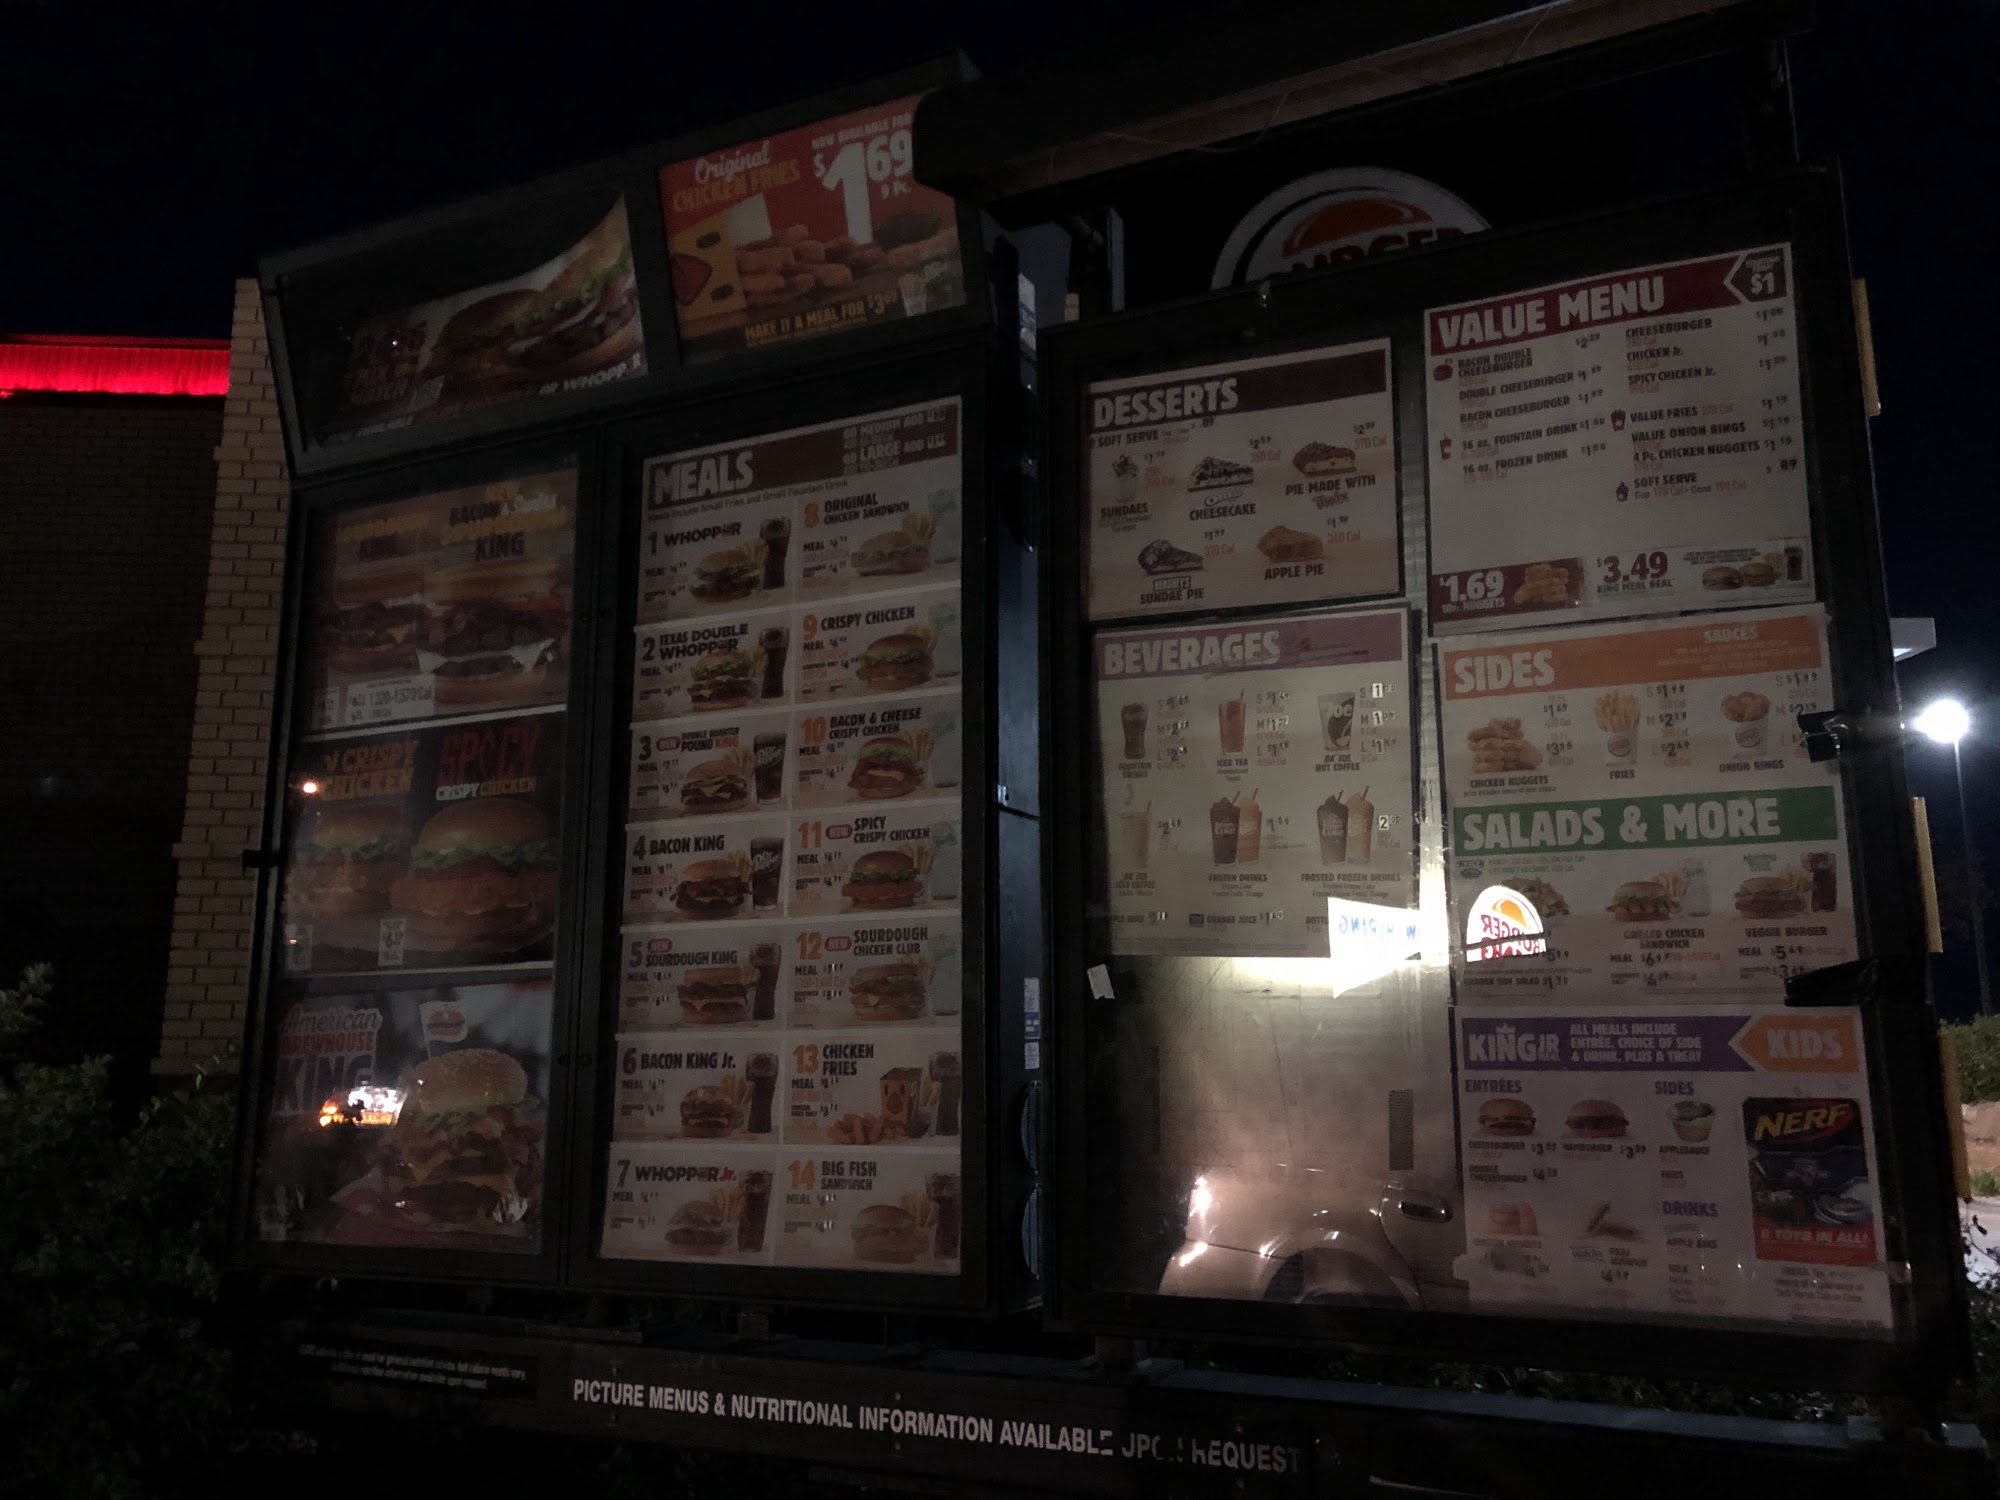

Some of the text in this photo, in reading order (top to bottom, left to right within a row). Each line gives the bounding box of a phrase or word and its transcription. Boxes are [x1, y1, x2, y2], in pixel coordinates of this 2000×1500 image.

[694, 139, 772, 184] Original
[672, 158, 800, 212] CHICKEN FRIES
[1751, 271, 1776, 295] $1
[745, 320, 776, 342] MAKE
[806, 307, 839, 328] MEAL
[842, 300, 865, 321] FOR
[1438, 275, 1666, 349] VALUE MENU
[1625, 317, 1713, 338] CHEESEBURGER
[1459, 348, 1533, 368] BACON DOUBLE
[1626, 347, 1670, 362] CHICKEN
[562, 352, 642, 391] WHOPPR
[1459, 358, 1533, 377] CHEESEBURGER
[1628, 366, 1702, 385] SPICY CHICKEN
[1459, 371, 1574, 399] DOUBLE CHEESEBURGER
[1094, 378, 1239, 428] DESSERTS
[1460, 395, 1571, 423] BACON CHEESEBURGER
[860, 414, 901, 436] MEDIUM
[1630, 406, 1699, 423] VALUE FRIES
[1098, 434, 1123, 447] SOFT
[1126, 429, 1159, 444] SERVE
[1462, 423, 1577, 451] 16 FOUNTAIN DRINK
[1631, 422, 1746, 442] VALUE ONION RINGS
[860, 439, 901, 460] LARGE
[1495, 449, 1568, 470] FROZEN DRINK
[1659, 440, 1760, 460] CHICKEN NUGGETS
[653, 450, 754, 504] MEALS
[826, 478, 849, 492] Drink
[1285, 474, 1376, 496] PIE MADE WITH
[1634, 473, 1697, 488] SOFT SERVE
[804, 492, 879, 528] 8 ORIGINAL
[823, 500, 910, 525] CHICKEN SANDWICH
[1101, 502, 1149, 519] SUNDAES
[1189, 503, 1256, 521] CHEESECAKE
[475, 531, 525, 561] KING
[648, 531, 658, 556] 1
[1264, 562, 1325, 581] APPLE PIE
[1597, 551, 1668, 584] $3.49
[1140, 587, 1205, 605] SUNDAE PIE
[802, 605, 916, 641] 9 CRISPY CHICKEN
[642, 621, 749, 663] 2 TEXAS DOUBLE
[1704, 626, 1759, 643] SAUCES
[1104, 629, 1282, 676] BEVERAGES
[1454, 649, 1555, 694] SIDES
[802, 707, 922, 744] 10 BACON CHEESE
[829, 723, 901, 741] CRISPY CHICKEN
[638, 735, 652, 762] 3
[681, 738, 713, 752] POUND
[1333, 761, 1360, 771] COFFEE
[1609, 769, 1635, 780] FRIES
[1719, 759, 1785, 773] ONION RINGS
[479, 776, 537, 797] CHICKEN
[1470, 773, 1549, 787] CHICKEN NUGGETS
[798, 815, 888, 849] 11 SPICY
[1463, 797, 1781, 851] SALADS & MORE
[853, 826, 931, 844] CRISPY CHICKEN
[632, 834, 725, 860] 4 BACON KING
[1665, 928, 1705, 938] CHICKEN
[1785, 926, 1828, 937] BURGER
[629, 940, 643, 967] 5
[795, 926, 928, 960] 12 SOURDOUGH
[853, 942, 921, 957] CHICKEN CLUB
[1640, 939, 1690, 950] SANDWICH
[645, 950, 738, 968] SOURDOUGH KING
[795, 964, 818, 976] MEAL
[281, 1004, 379, 1033] American
[1570, 1022, 1677, 1035] ALL MEALS INCLUDE
[1468, 1031, 1559, 1063] KING JR
[1618, 1037, 1655, 1050] CHOICE
[1659, 1037, 1673, 1049] OF
[1676, 1037, 1702, 1050] SIDE
[1766, 1027, 1843, 1060] KIDS
[623, 1047, 737, 1075] 6 BACON KING Jr.
[792, 1043, 875, 1074] 13 CHICKEN
[1625, 1051, 1653, 1063] PLUS
[1656, 1051, 1665, 1063] A
[1668, 1051, 1702, 1063] TREAT
[822, 1060, 858, 1076] FRIES
[792, 1078, 815, 1089] MEAL
[1655, 1081, 1695, 1096] SIDES
[1754, 1103, 1850, 1142] NERF
[1659, 1145, 1711, 1155] APPLESAUCE
[617, 1159, 631, 1188] 7
[788, 1160, 877, 1191] 14 BIG FISH
[821, 1178, 873, 1190] SANDWICH
[1662, 1201, 1719, 1217] DRINKS
[1815, 1230, 1833, 1243] IN
[573, 1378, 645, 1408] PICTURE
[649, 1385, 709, 1414] MENUS
[713, 1393, 726, 1417] &
[731, 1394, 854, 1429] NUTRITIONAL
[858, 1406, 994, 1443] INFORMATION
[1000, 1420, 1114, 1456] AVAILABLE
[1191, 1438, 1302, 1473] REQUEST
